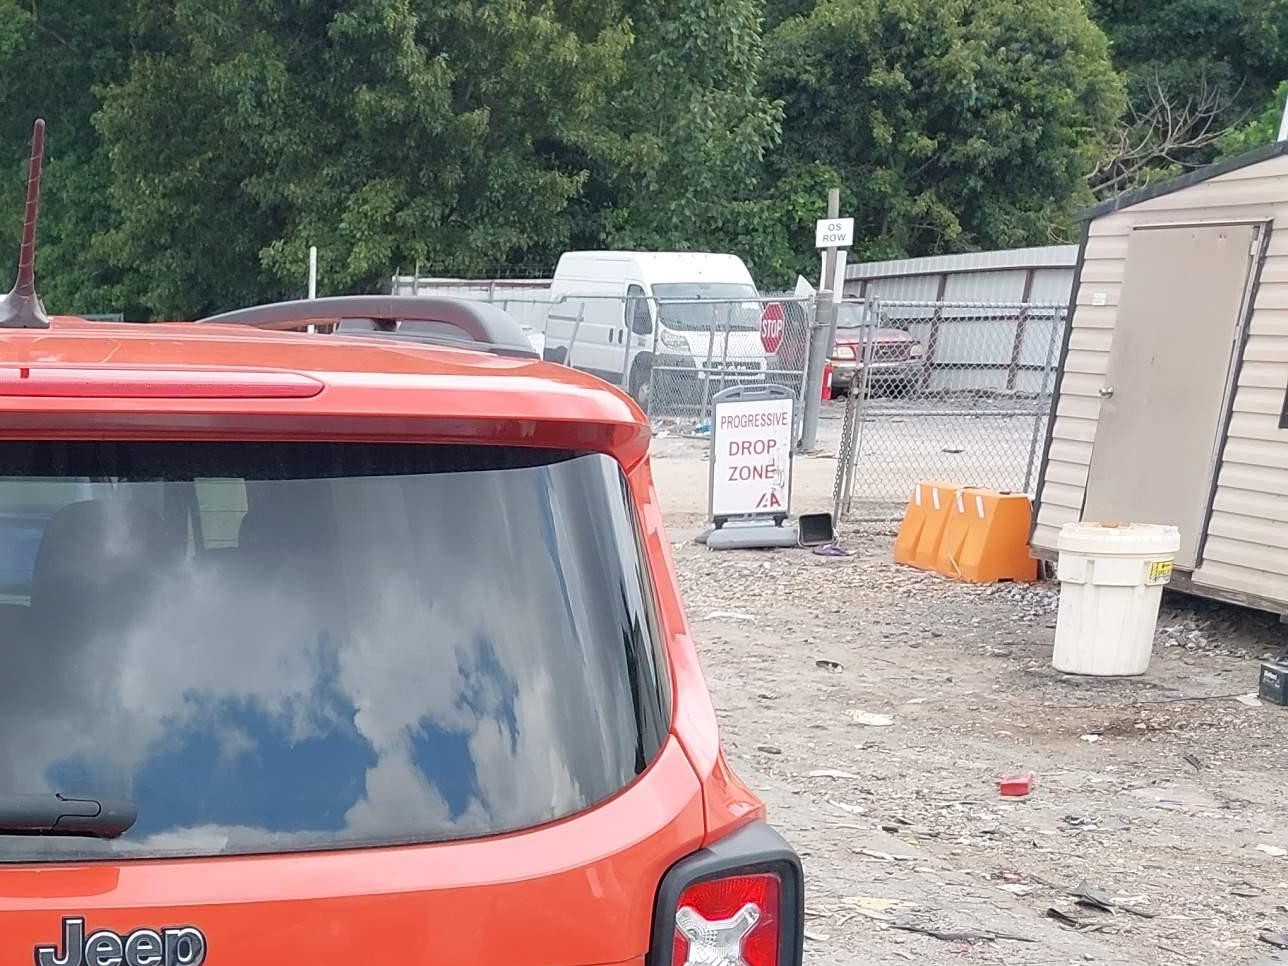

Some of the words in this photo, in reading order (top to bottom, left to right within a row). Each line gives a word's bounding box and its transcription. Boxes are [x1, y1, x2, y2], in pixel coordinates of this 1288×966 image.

[827, 223, 842, 232] OS
[822, 233, 846, 242] ROW
[762, 319, 782, 337] STOP
[720, 411, 789, 430] PROGRESSIVE
[728, 439, 777, 457] DROP
[727, 464, 776, 482] ZONE
